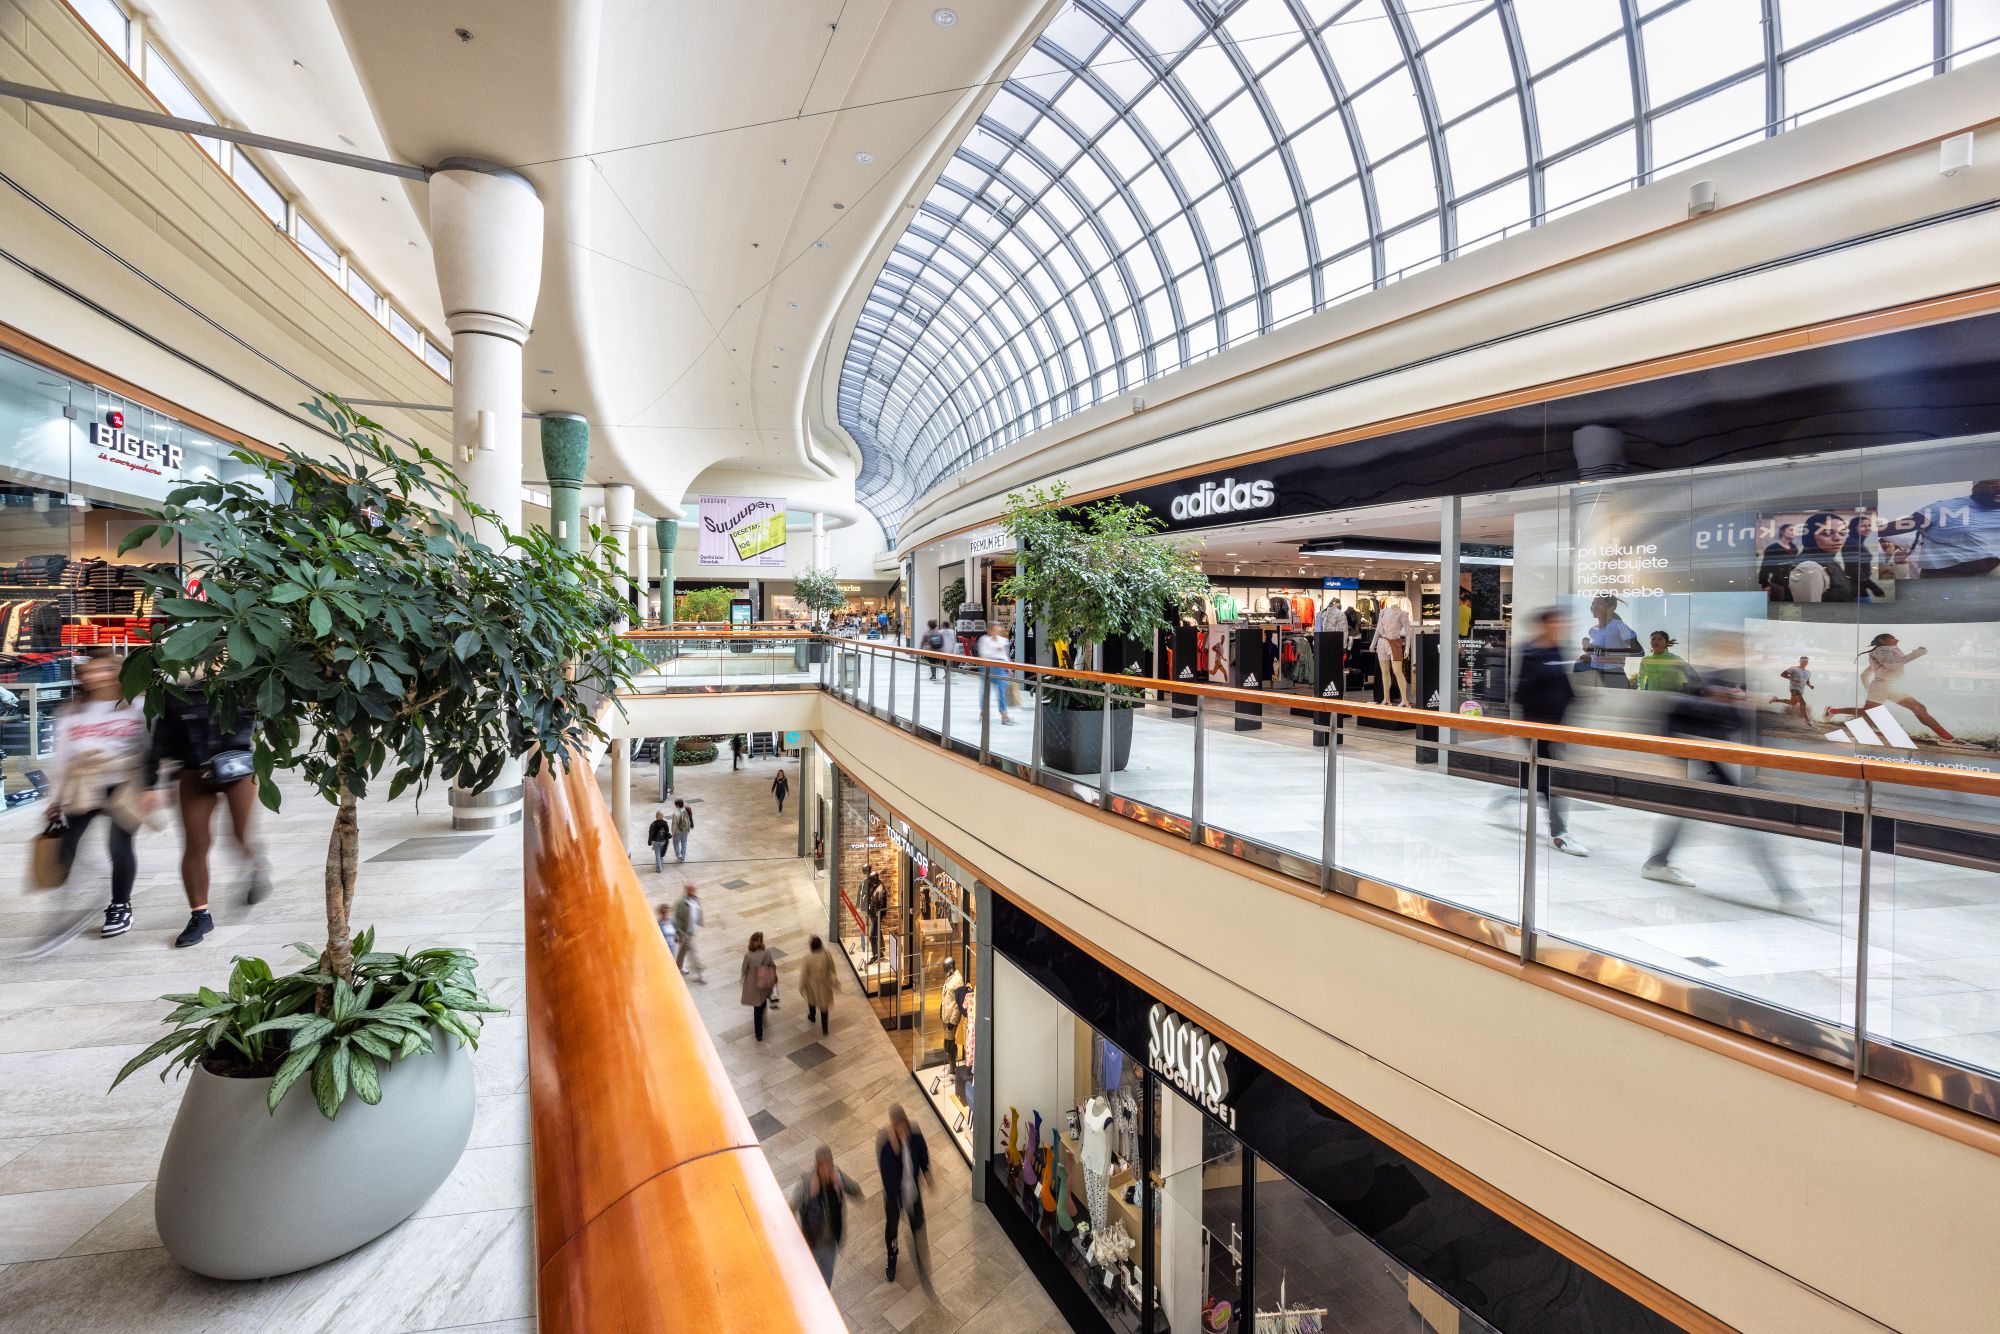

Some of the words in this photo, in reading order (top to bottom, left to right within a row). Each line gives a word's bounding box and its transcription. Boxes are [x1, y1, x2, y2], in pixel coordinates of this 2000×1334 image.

[1171, 478, 1275, 520] adidas
[970, 537, 994, 552] PREMIUM
[995, 534, 1005, 546] PET
[1577, 545, 1596, 560] pri
[1600, 544, 1633, 556] teku
[1636, 544, 1657, 554] ne
[1577, 556, 1668, 573] potrebujete
[1577, 573, 1634, 585] ničesar,
[1577, 589, 1618, 598] razen
[1622, 586, 1664, 598] sebe
[1149, 1003, 1229, 1104] SOCKS
